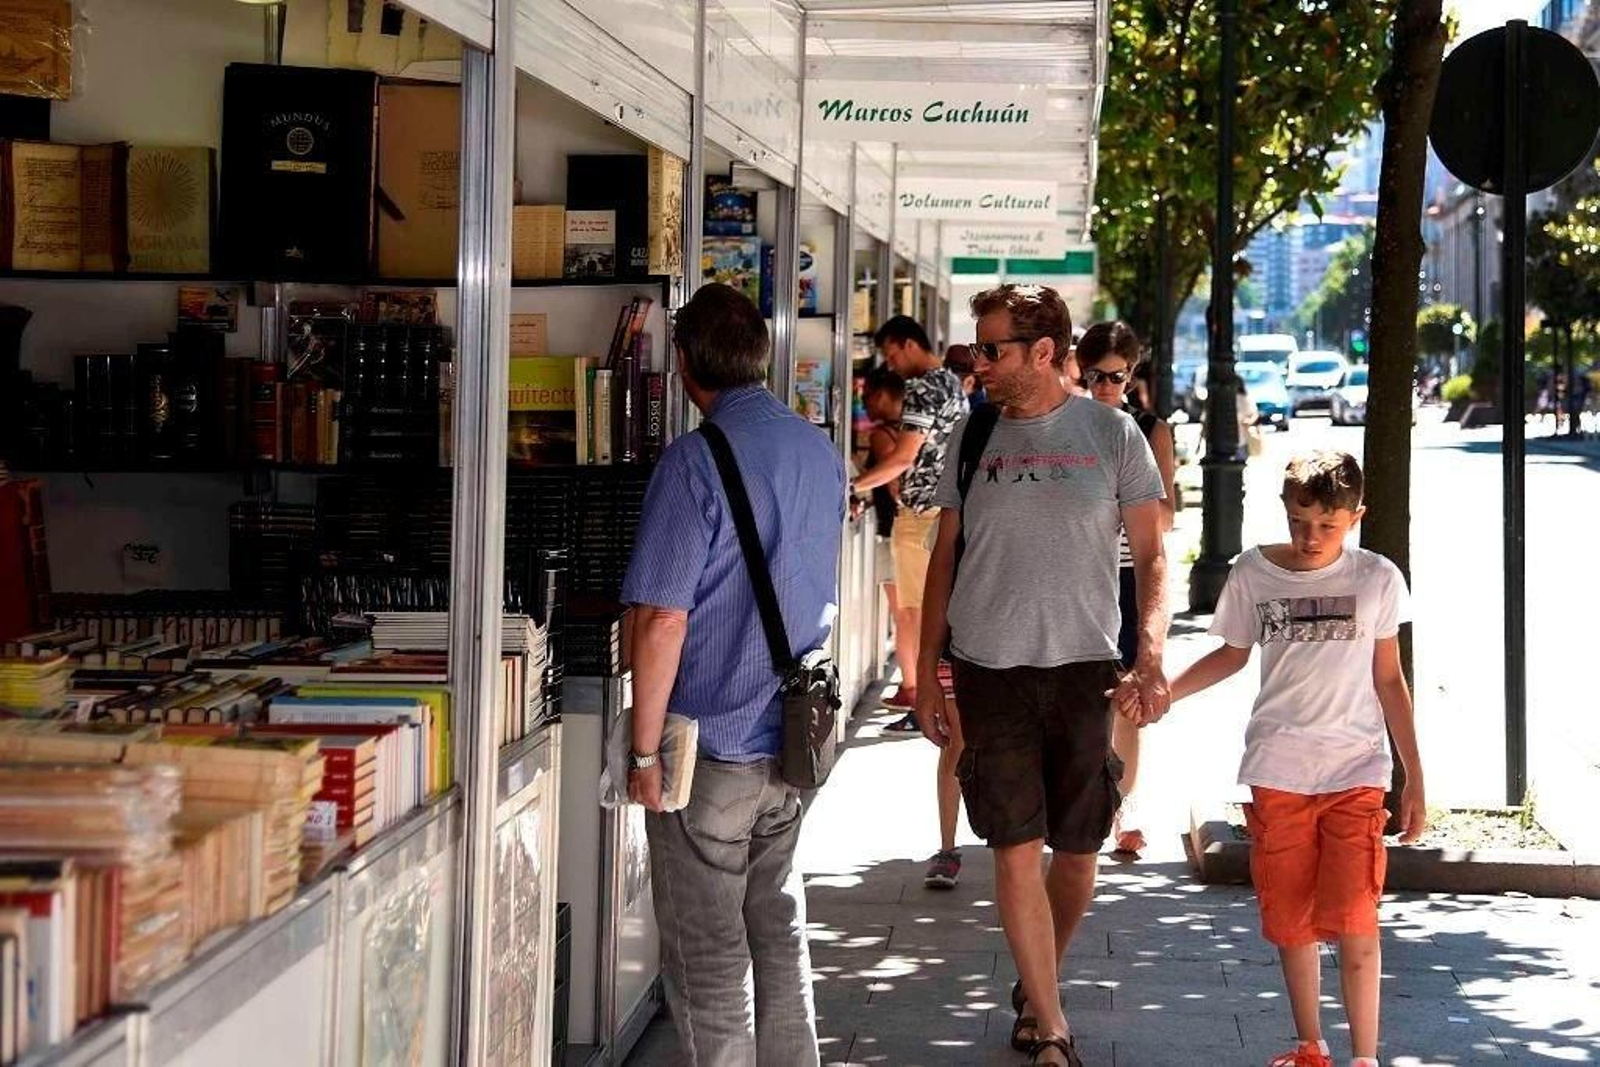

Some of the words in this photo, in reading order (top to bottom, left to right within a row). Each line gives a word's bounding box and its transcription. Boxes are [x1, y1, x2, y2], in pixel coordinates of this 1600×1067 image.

[818, 98, 914, 123] Marcos
[922, 100, 1030, 123] Cachuán
[270, 112, 331, 131] MUNDUS
[899, 193, 973, 209] Volumen
[977, 193, 1052, 209] Cultural
